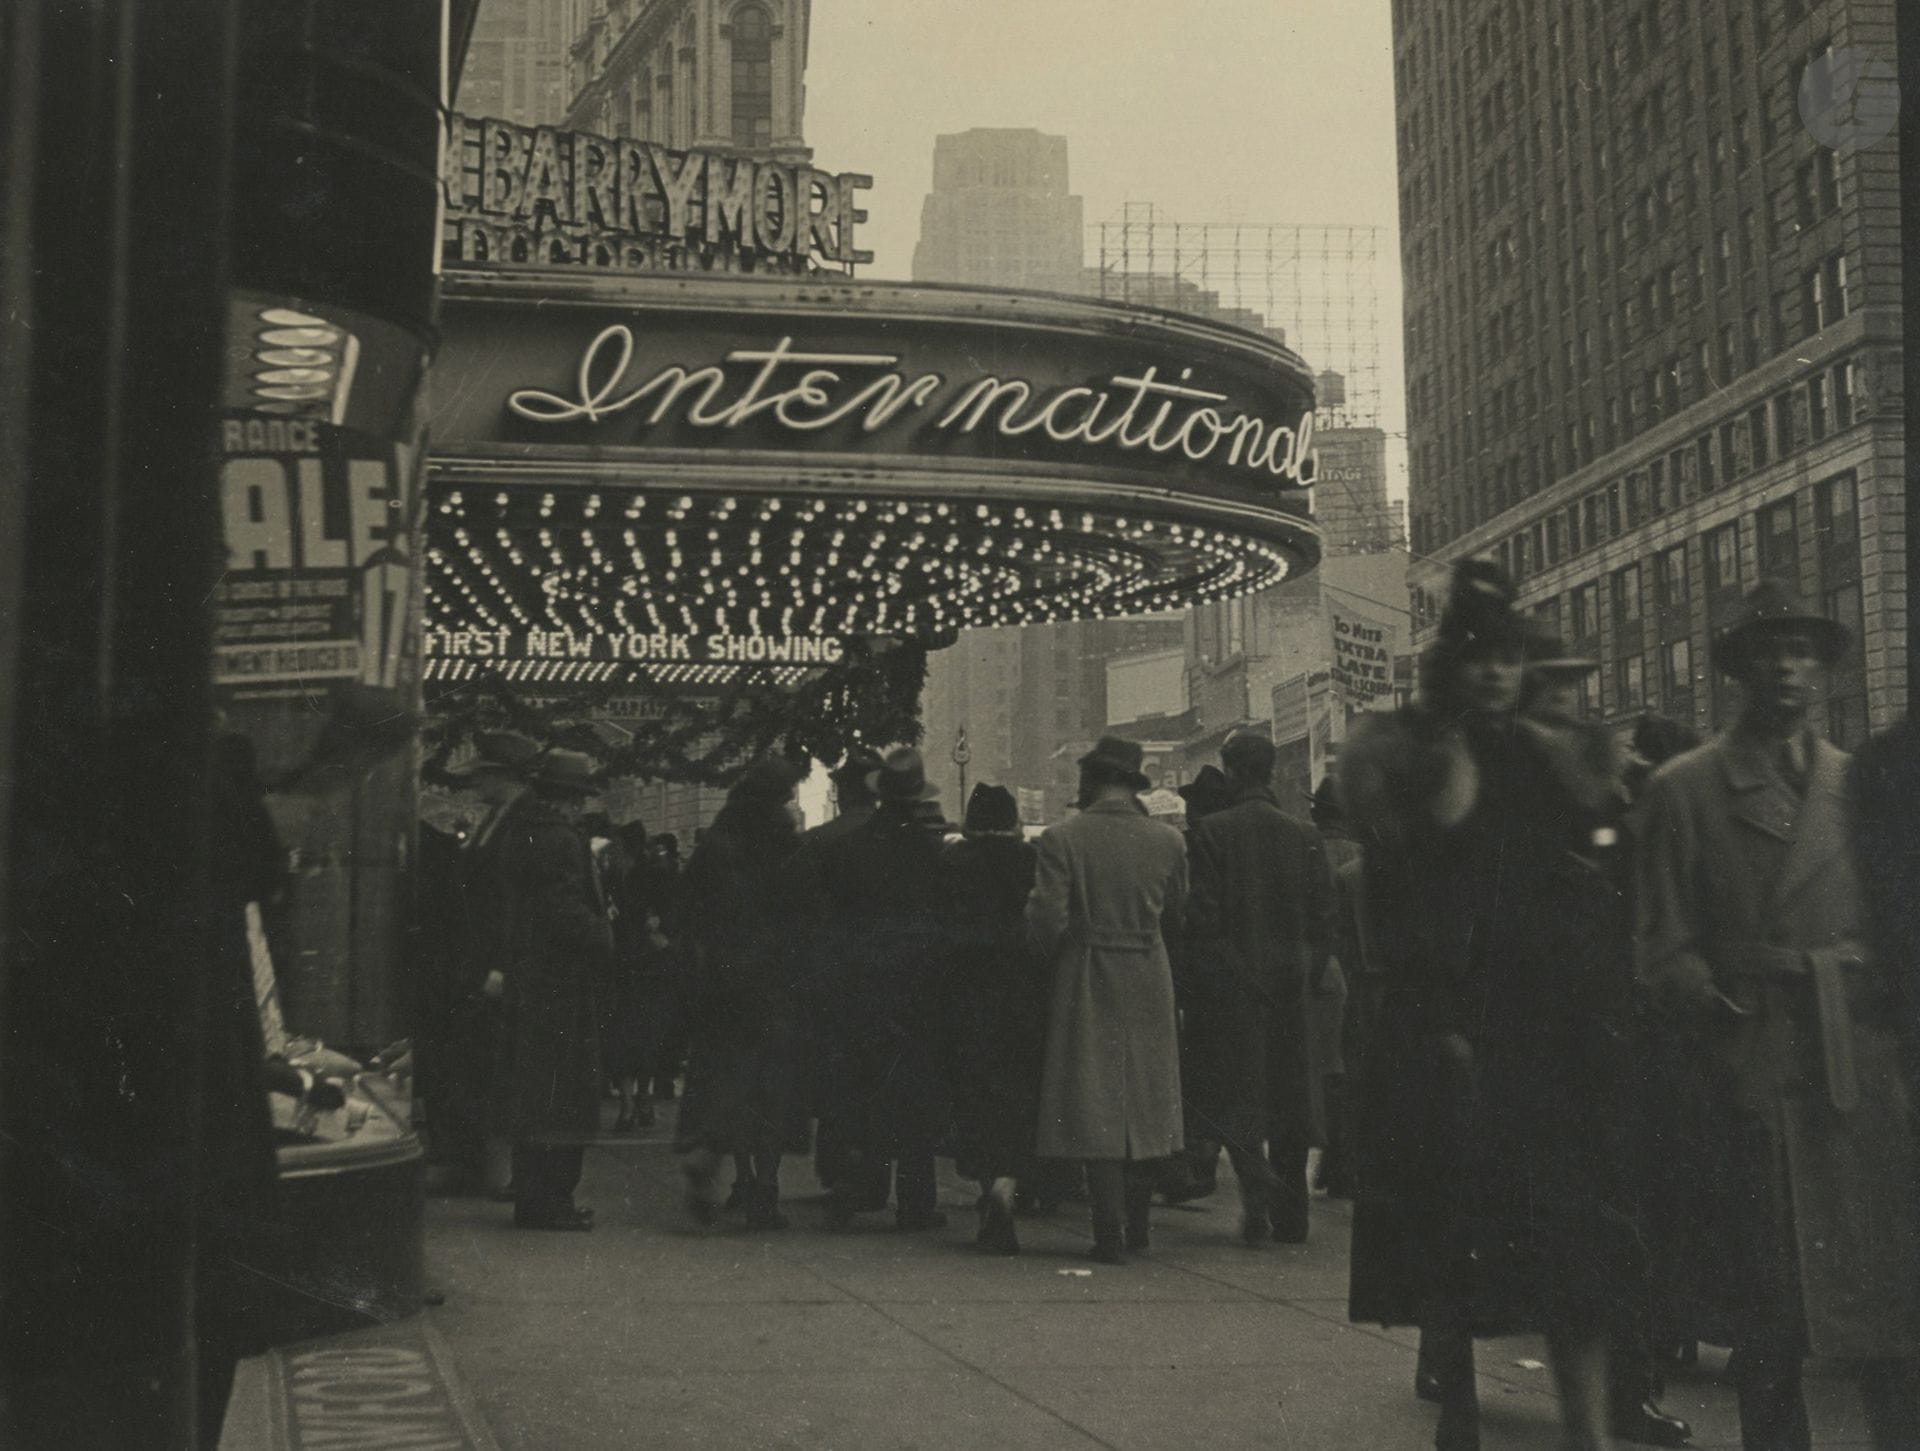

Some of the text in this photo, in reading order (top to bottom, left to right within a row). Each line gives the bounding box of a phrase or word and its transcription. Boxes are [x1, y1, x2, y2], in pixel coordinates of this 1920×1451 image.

[482, 115, 875, 265] BARRYMORE
[507, 324, 1318, 486] International
[424, 630, 844, 663] FIRST NEW YORK SHOWING
[1334, 637, 1388, 663] EXTRA
[1337, 655, 1386, 680] LATE
